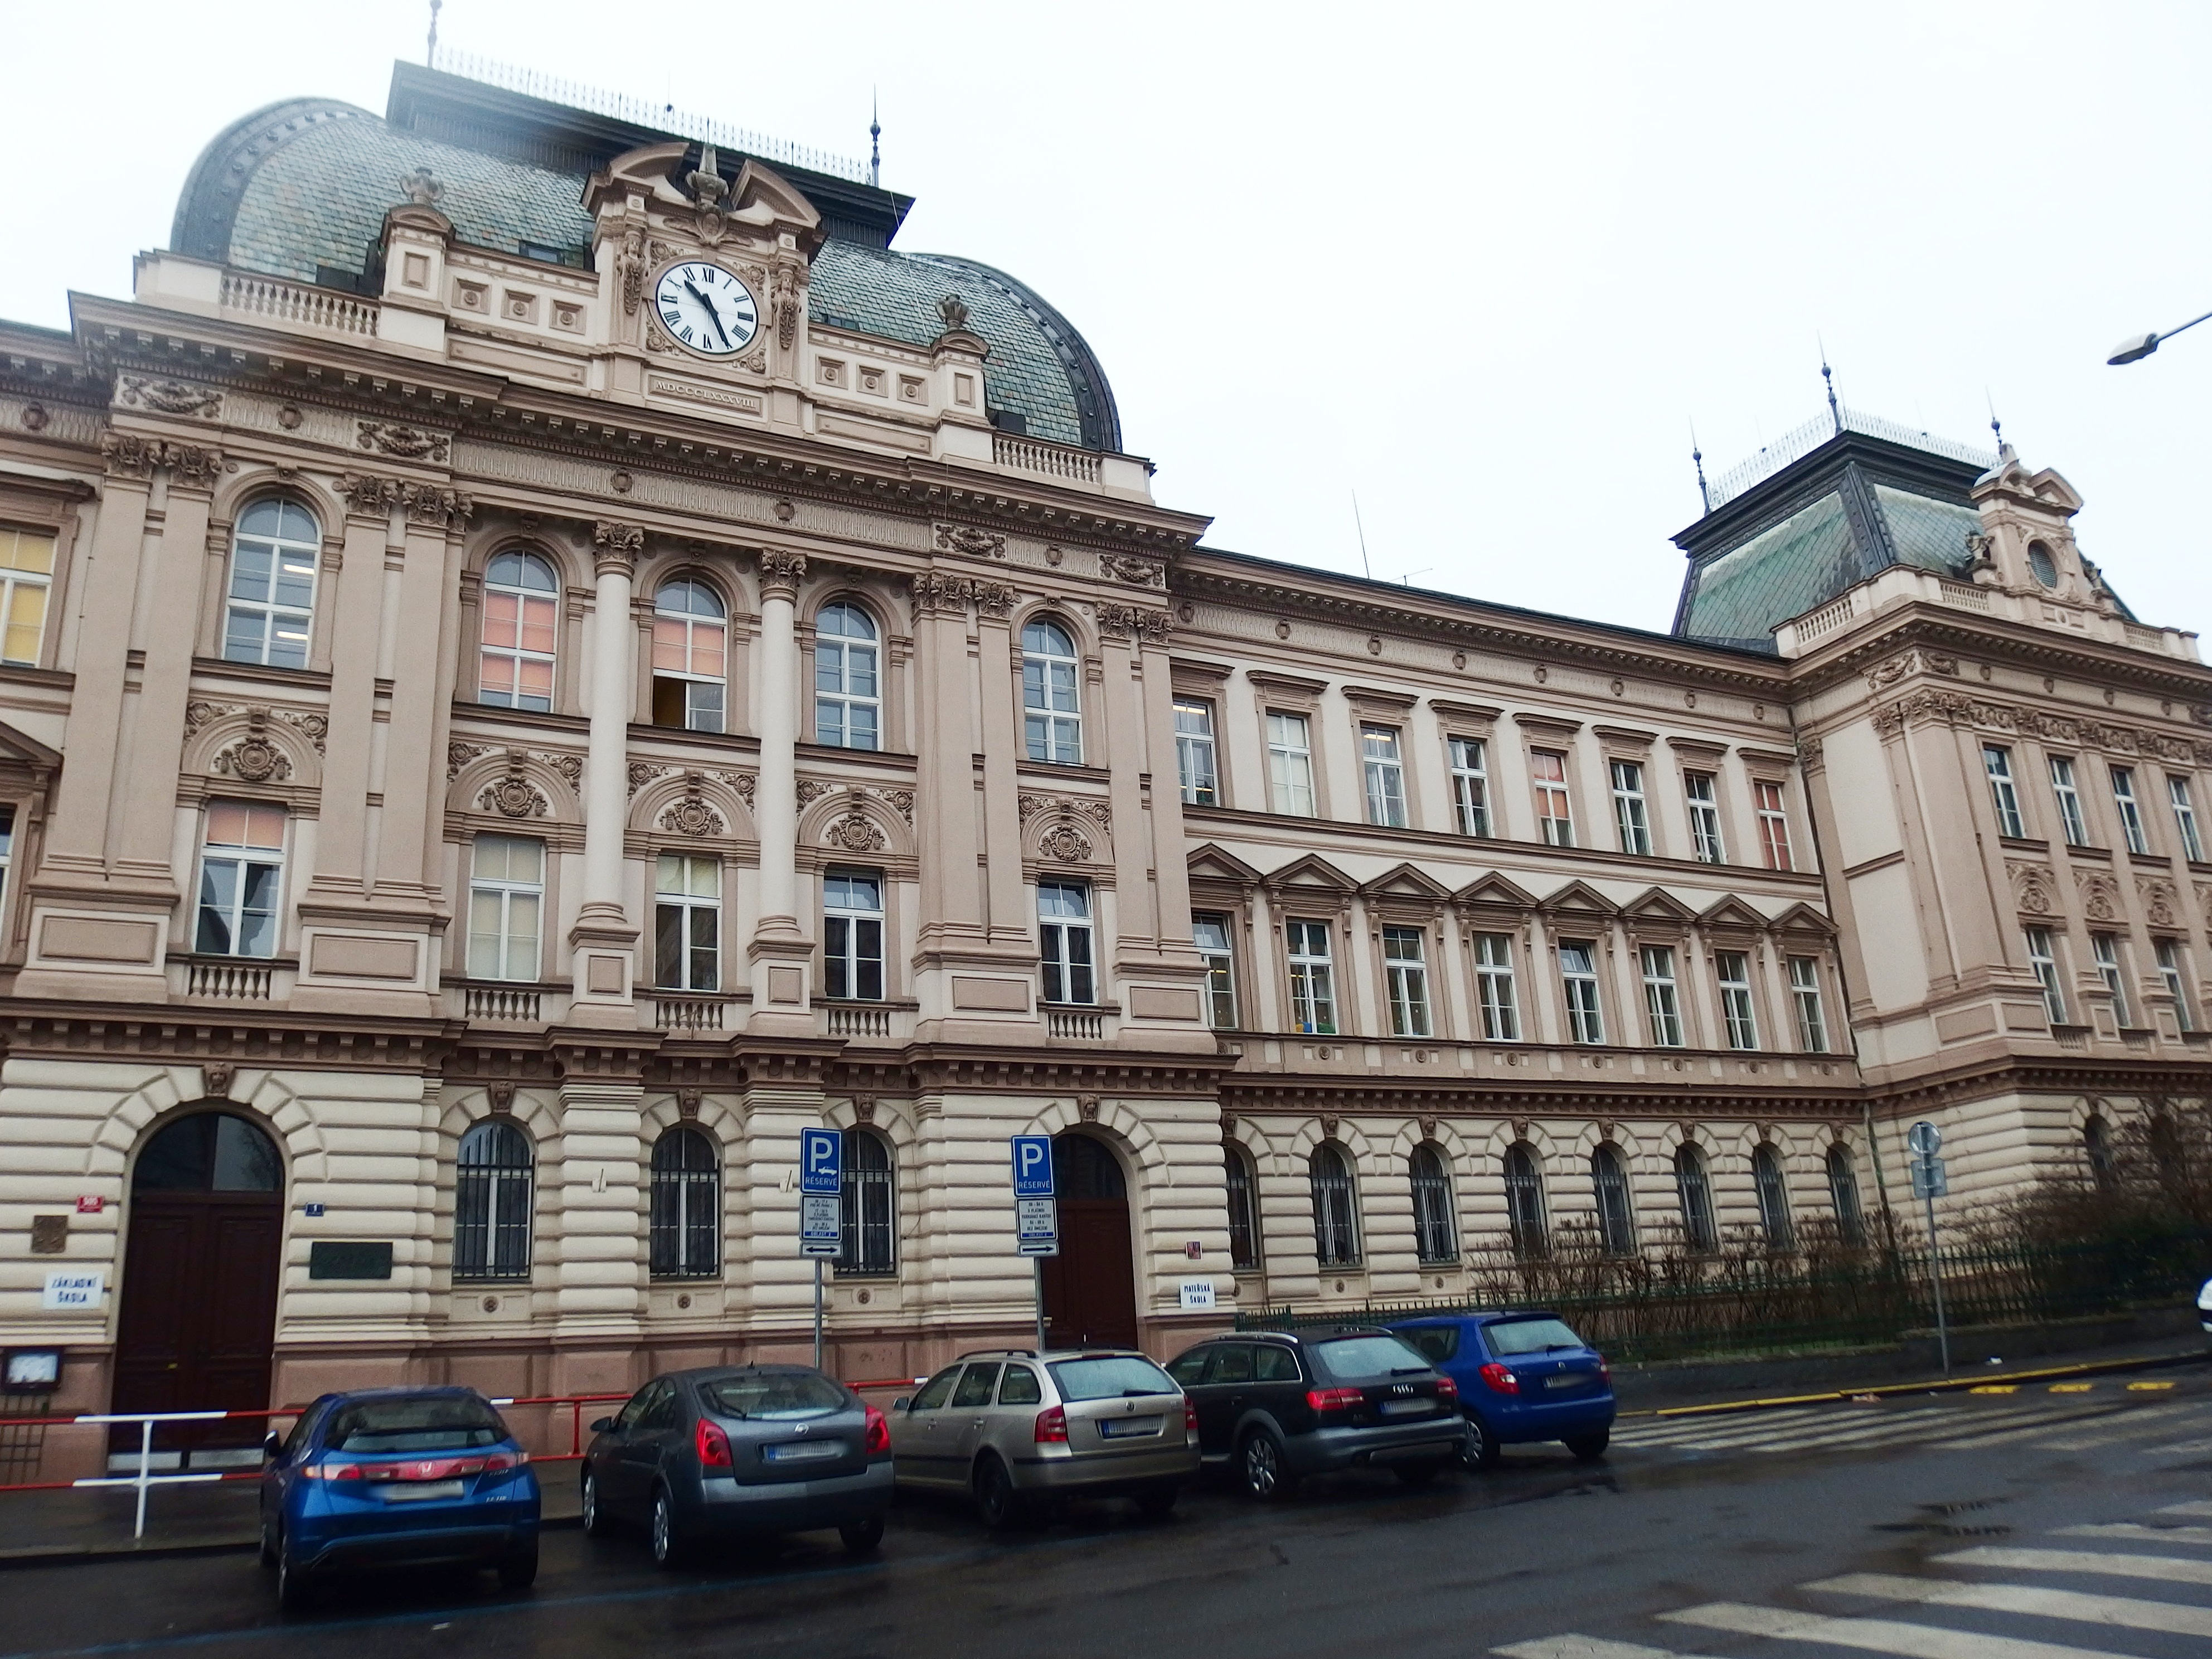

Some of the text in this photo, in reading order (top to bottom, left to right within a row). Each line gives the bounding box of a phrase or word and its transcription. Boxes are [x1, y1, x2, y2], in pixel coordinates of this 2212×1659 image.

[682, 266, 696, 282] XI
[702, 267, 715, 283] XII
[666, 276, 682, 291] X
[723, 277, 732, 289] I
[733, 294, 749, 303] II
[738, 311, 753, 322] III
[703, 333, 712, 349] VI
[656, 381, 756, 408] MDCCCLXXXVIII
[811, 1137, 833, 1172] P
[1021, 1143, 1043, 1177] P
[805, 1175, 837, 1186] RÉSERVÉ
[1018, 1179, 1050, 1189] RÉSERVÉ
[1184, 1283, 1210, 1293] MATEŘSKÁ
[1190, 1294, 1206, 1303] ŠKOLA
